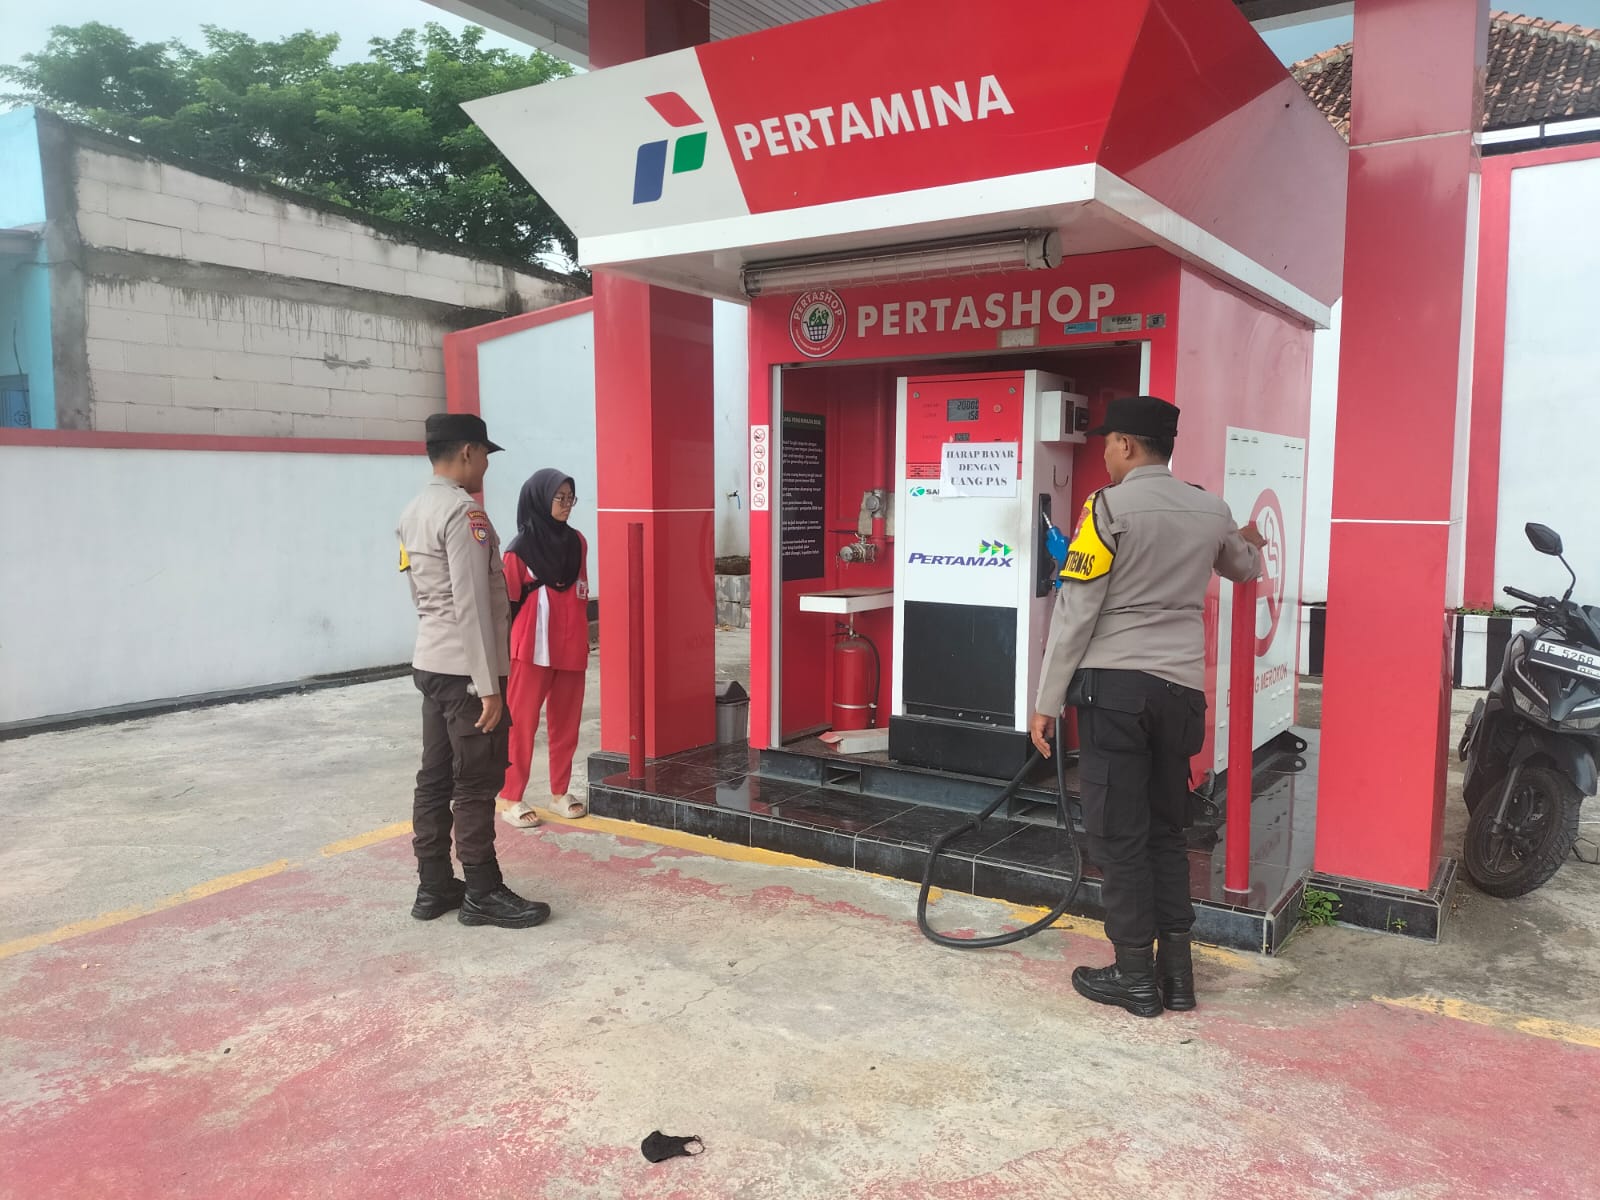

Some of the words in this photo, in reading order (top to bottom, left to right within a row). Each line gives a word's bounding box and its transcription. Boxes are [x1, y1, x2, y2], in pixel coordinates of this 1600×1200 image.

[734, 74, 1016, 161] PERTAMINA
[793, 290, 843, 321] PERTASHOP
[857, 283, 1116, 337] PERTASHOP
[946, 450, 980, 459] HARAP
[982, 450, 1014, 459] BAYAR
[958, 463, 1001, 472] DENGAN
[950, 477, 983, 486] UANG
[986, 477, 1008, 486] PAS
[908, 552, 1014, 568] PERTAMAX
[1260, 663, 1289, 691] MEROKOK
